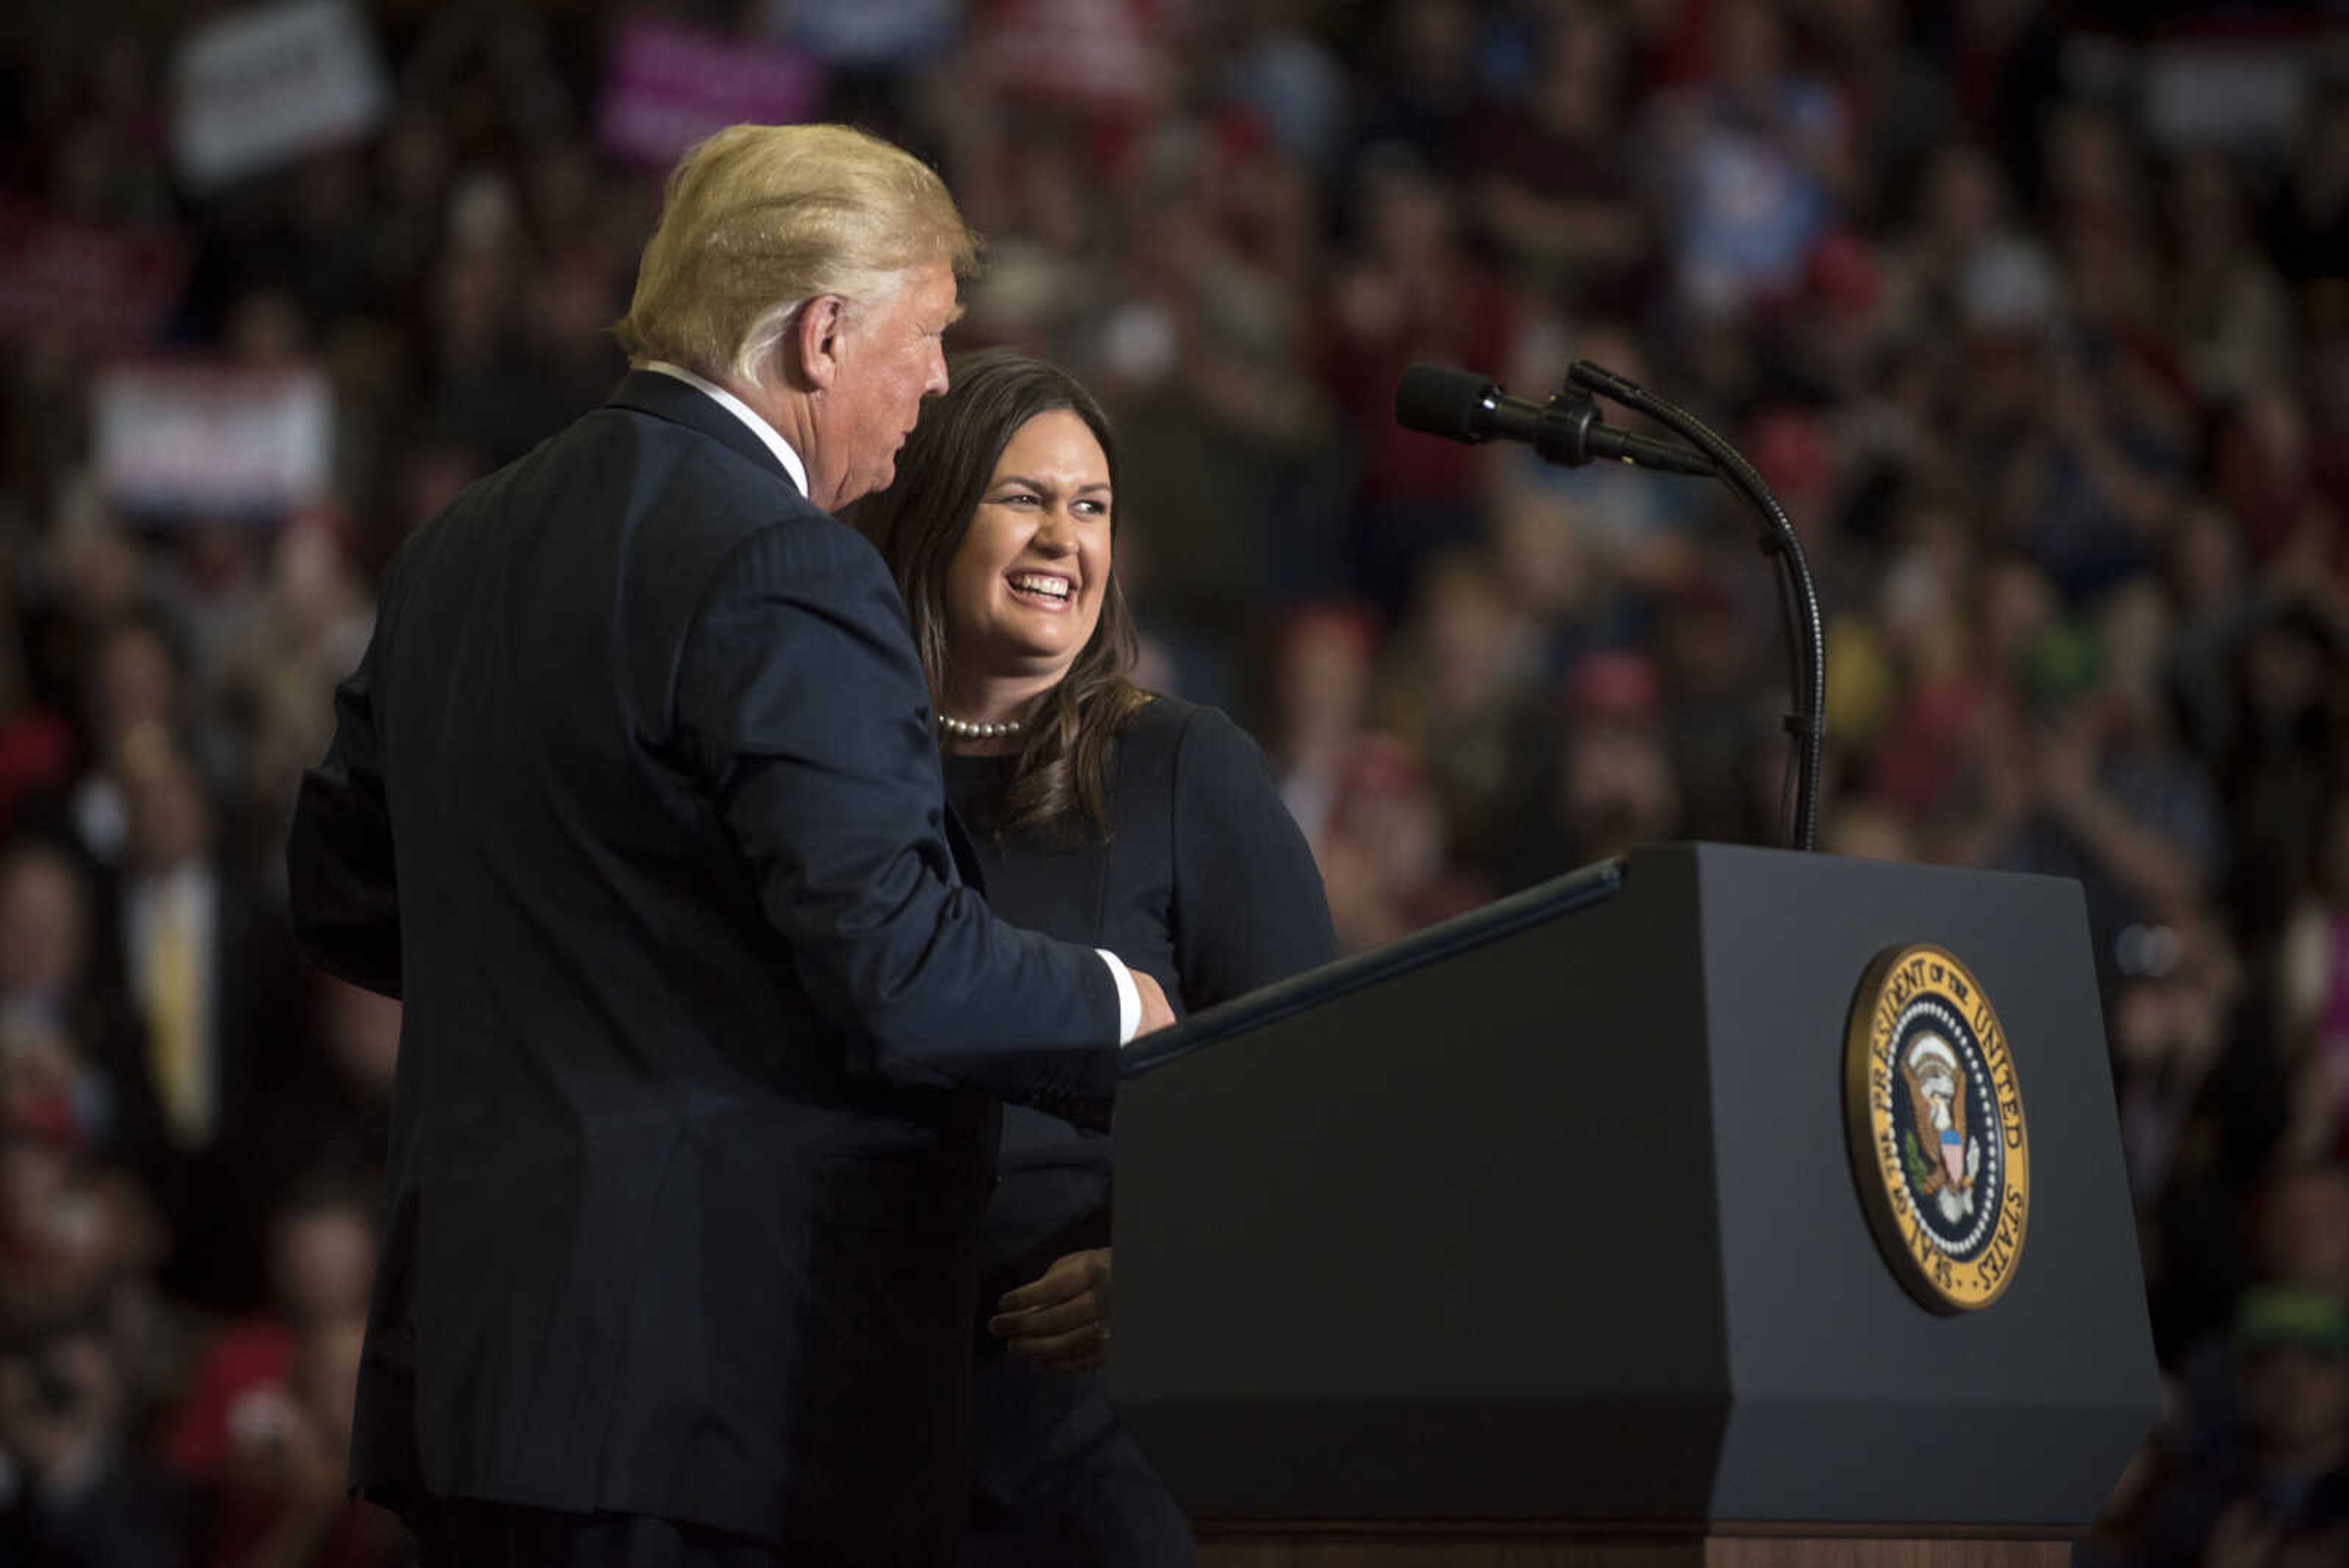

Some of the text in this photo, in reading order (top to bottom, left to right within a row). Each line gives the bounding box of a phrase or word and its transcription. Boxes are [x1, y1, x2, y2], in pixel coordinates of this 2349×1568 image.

[1930, 963, 1945, 982] OF
[1948, 970, 1968, 1005] THE
[1873, 959, 1926, 1112] PRESIDENT
[1975, 1004, 2021, 1148] UNITED
[1893, 1188, 1907, 1213] OF
[1912, 1221, 1951, 1289] SEAL
[1977, 1184, 2022, 1290] STATES
